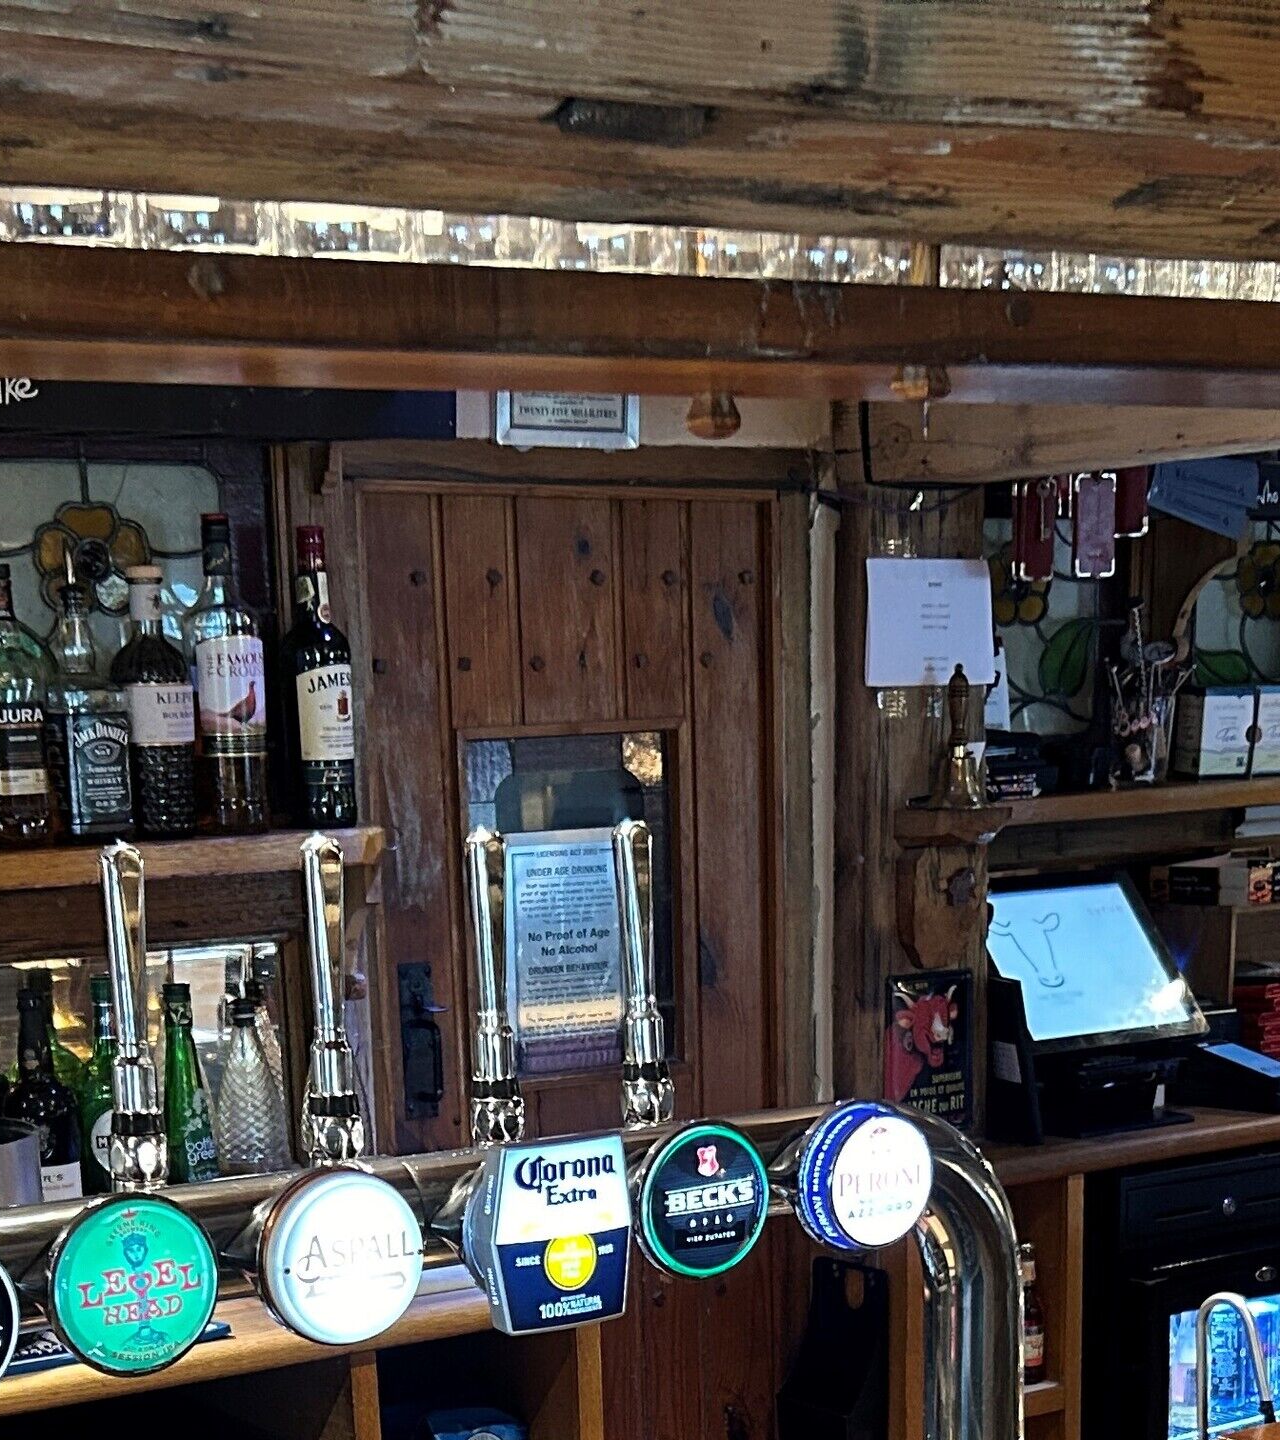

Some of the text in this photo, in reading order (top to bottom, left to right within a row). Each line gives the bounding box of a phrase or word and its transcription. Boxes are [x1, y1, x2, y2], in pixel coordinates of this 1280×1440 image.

[526, 864, 608, 878] UNDER AGE DRINKING
[528, 927, 610, 943] No Proof of Age
[541, 942, 598, 957] No Alcohol
[950, 1094, 965, 1110] RIT
[513, 1154, 616, 1193] Corona
[838, 1164, 921, 1197] PERONI
[545, 1184, 597, 1207] Extra
[667, 1179, 755, 1214] BECK'S
[298, 1230, 415, 1274] ASPALL
[515, 1255, 541, 1267] SINCE
[78, 1259, 201, 1309] LEVEL
[103, 1294, 183, 1326] HEAD
[539, 1301, 570, 1320] 100%
